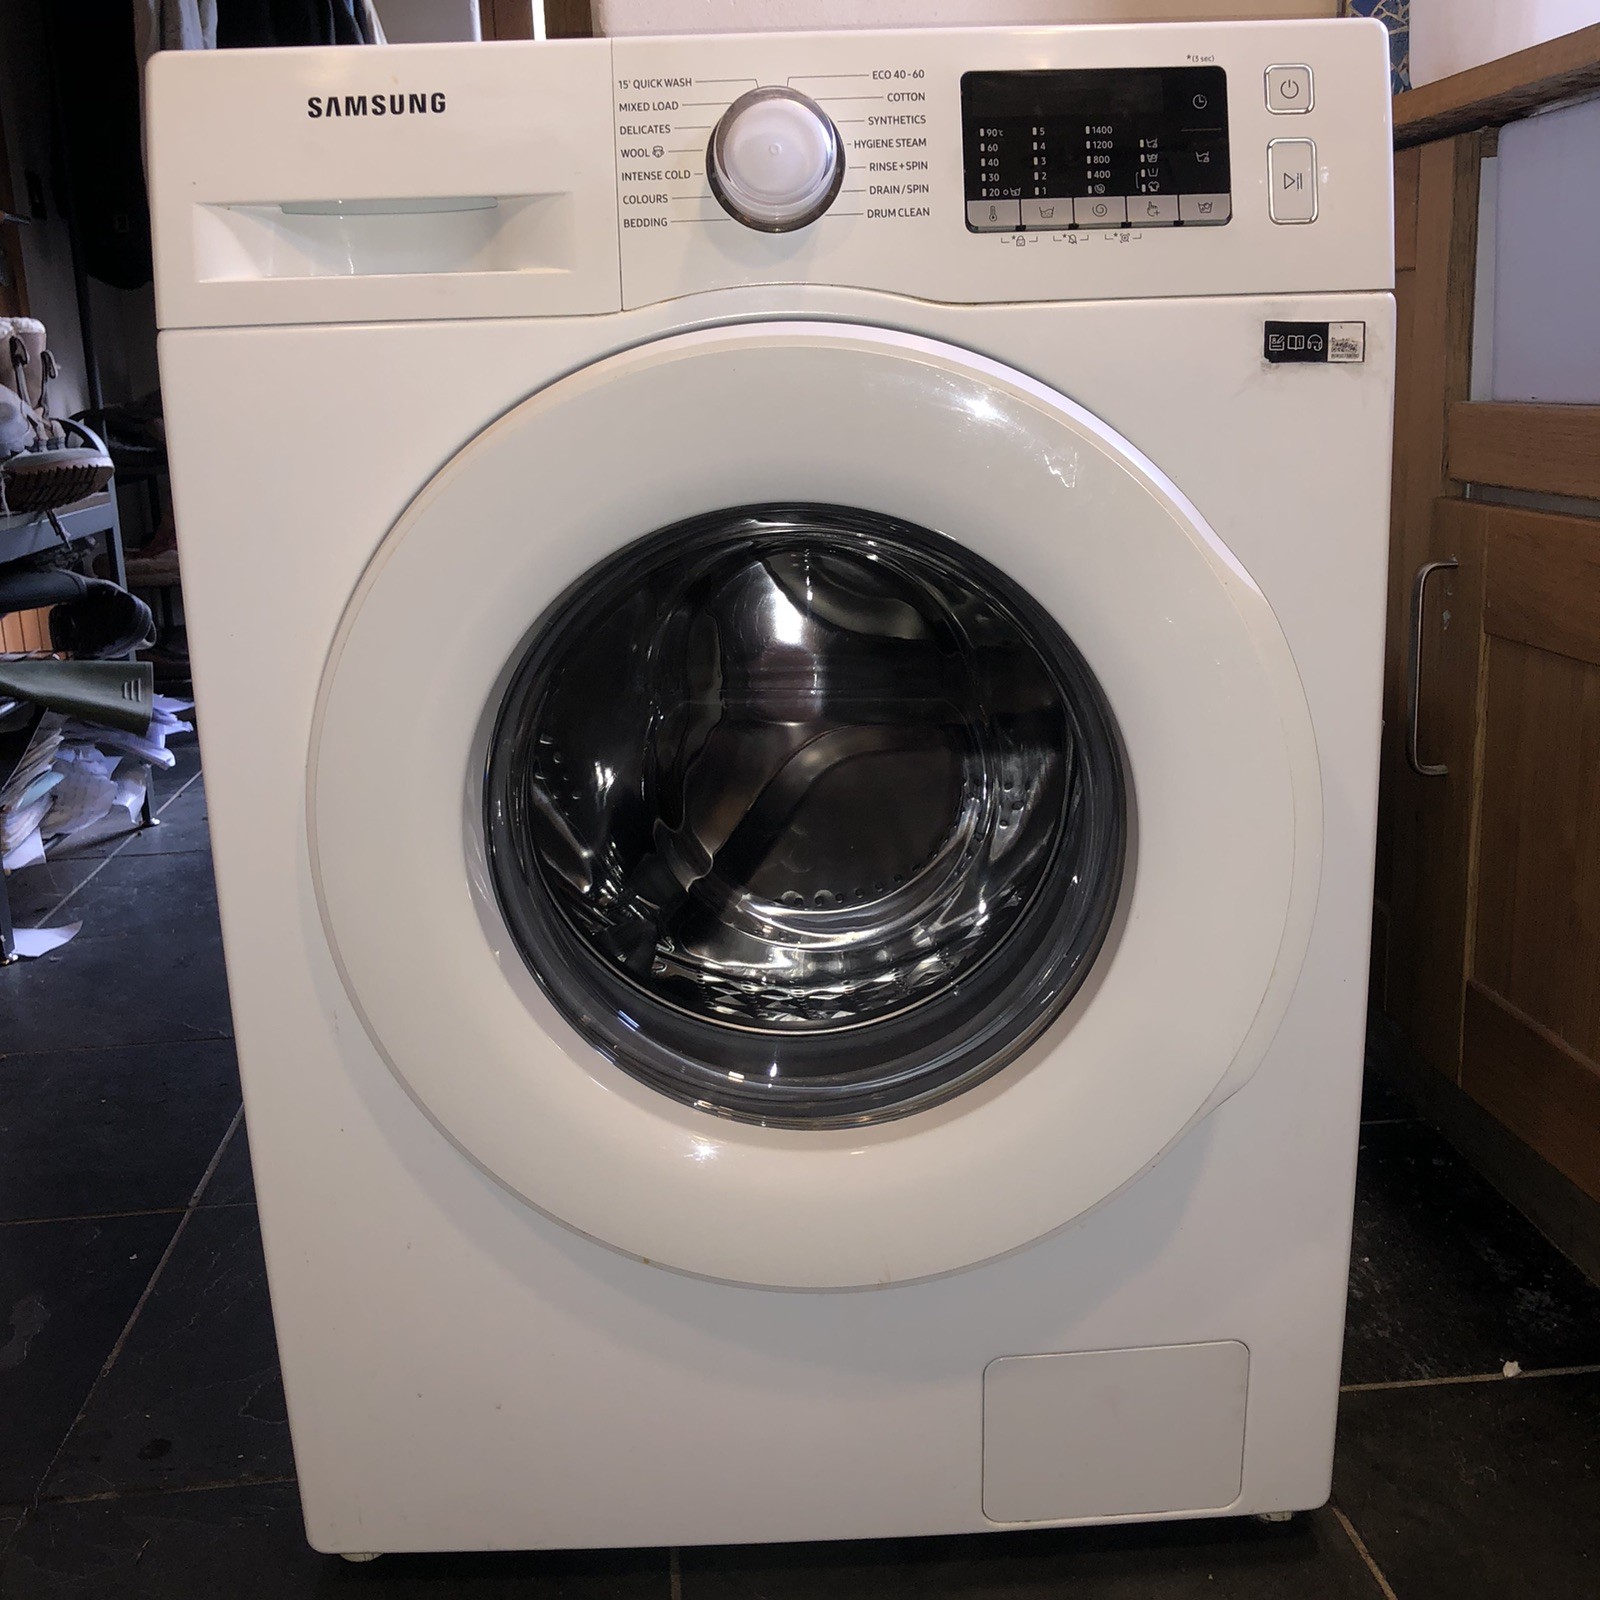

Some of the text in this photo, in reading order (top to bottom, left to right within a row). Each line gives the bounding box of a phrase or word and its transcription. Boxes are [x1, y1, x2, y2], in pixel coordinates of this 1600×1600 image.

[1200, 54, 1215, 62] sec)
[872, 70, 892, 80] ECO
[618, 77, 693, 91] 15' QUICK WASH
[887, 92, 926, 102] COTTON
[307, 92, 446, 119] SAMSUNG
[619, 101, 679, 112] MIXED LOAD
[868, 114, 927, 126] SYNTHETICS
[619, 124, 671, 136] DELICATES
[1039, 127, 1046, 136] 5
[1091, 125, 1113, 134] 1400
[854, 137, 927, 149] HYGIENE STEAM
[987, 143, 999, 152] 60
[1040, 142, 1046, 151] 4
[1092, 140, 1113, 149] 1200
[620, 148, 650, 158] WOOL
[988, 158, 1000, 167] 40
[1041, 157, 1047, 166] 3
[1093, 155, 1111, 164] 800
[621, 169, 691, 181] INTENSE COLD
[988, 173, 1000, 182] 30
[1041, 171, 1047, 181] 2
[1093, 170, 1111, 179] 400
[989, 188, 1001, 197] 20
[622, 193, 669, 205] COLOURS
[867, 207, 930, 219] DRUM CLEAN
[623, 217, 668, 228] BEDDING
